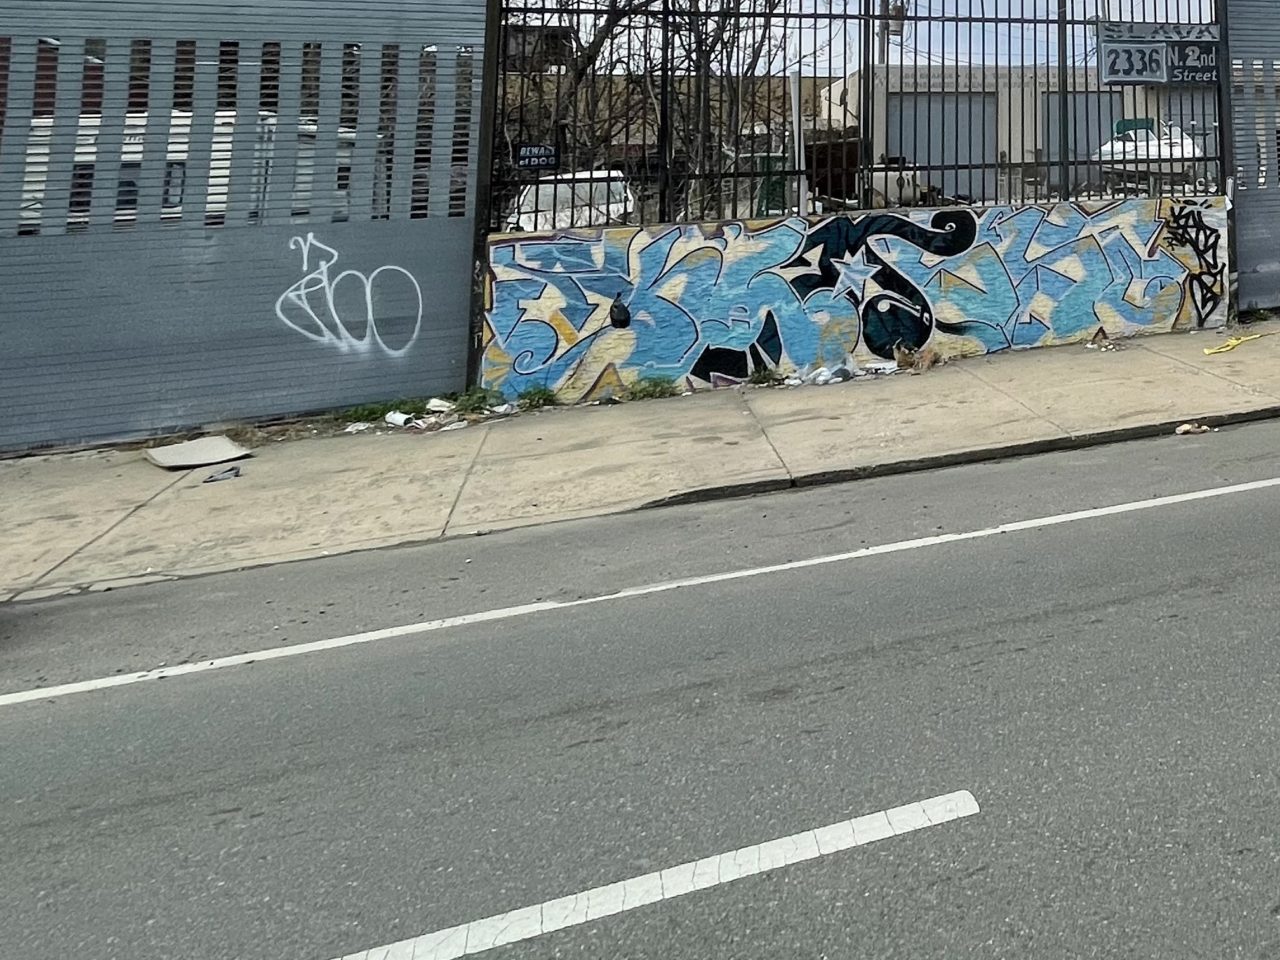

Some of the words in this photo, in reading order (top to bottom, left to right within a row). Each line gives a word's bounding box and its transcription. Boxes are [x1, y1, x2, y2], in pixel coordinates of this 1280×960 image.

[1106, 48, 1161, 76] 2336
[1185, 45, 1216, 67] 2nd
[1172, 68, 1218, 81] Street
